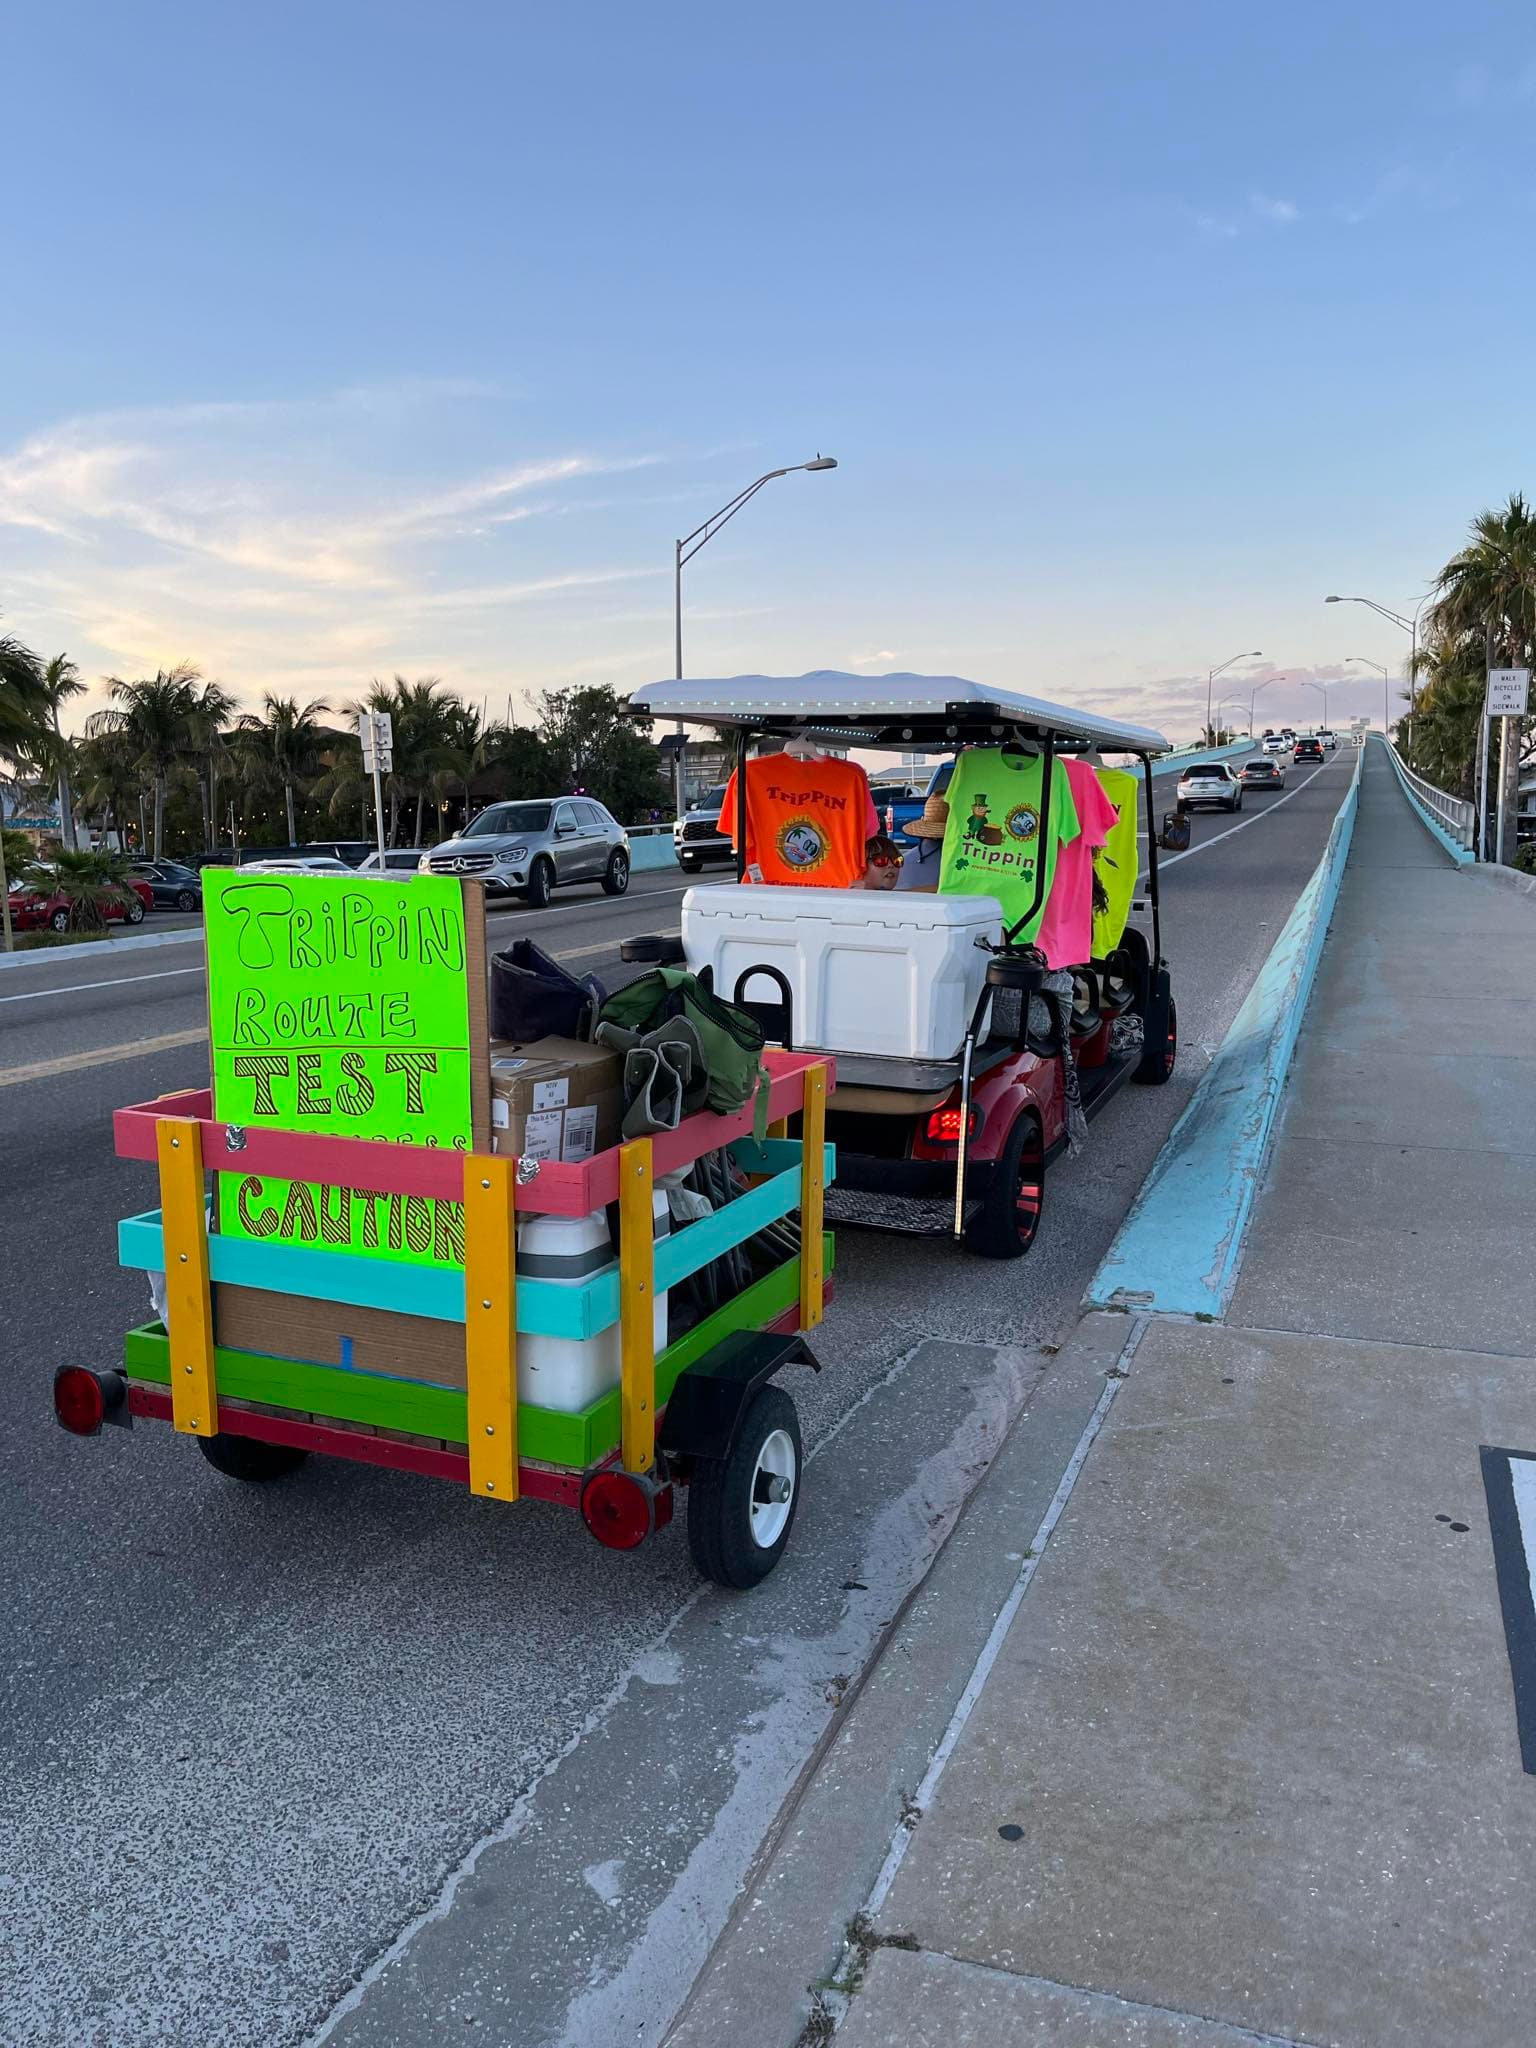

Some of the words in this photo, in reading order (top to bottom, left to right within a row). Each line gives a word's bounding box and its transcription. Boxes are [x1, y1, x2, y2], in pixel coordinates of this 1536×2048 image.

[1352, 735, 1364, 745] 35
[962, 842, 1035, 869] Trippin
[233, 988, 417, 1046] ROUTE
[234, 1052, 437, 1116] TEST
[238, 1175, 465, 1266] CAUTION
